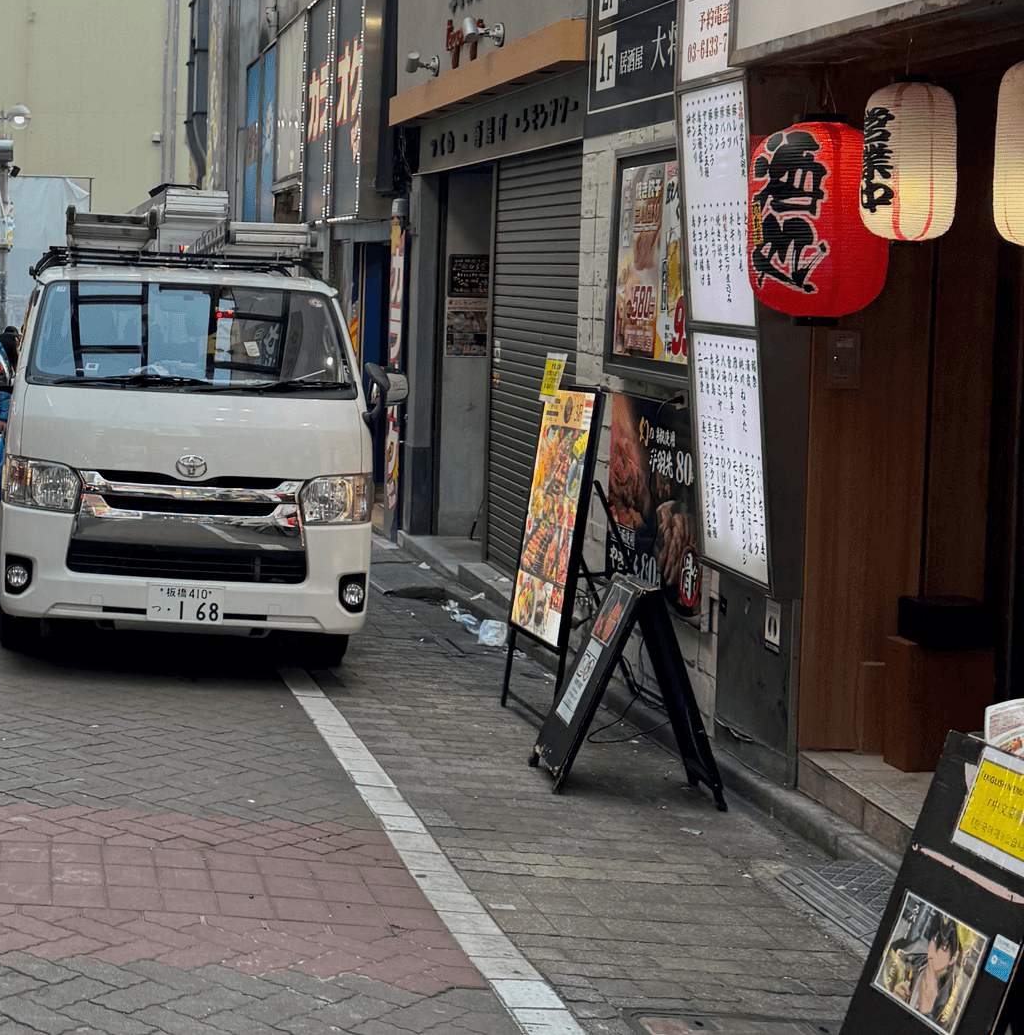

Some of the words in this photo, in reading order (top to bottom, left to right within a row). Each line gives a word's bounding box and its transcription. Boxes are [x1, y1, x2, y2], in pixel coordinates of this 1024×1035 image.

[599, 42, 614, 84] 1F
[619, 45, 644, 75] 居酒屋
[166, 587, 187, 598] 板橋
[188, 588, 208, 600] 410
